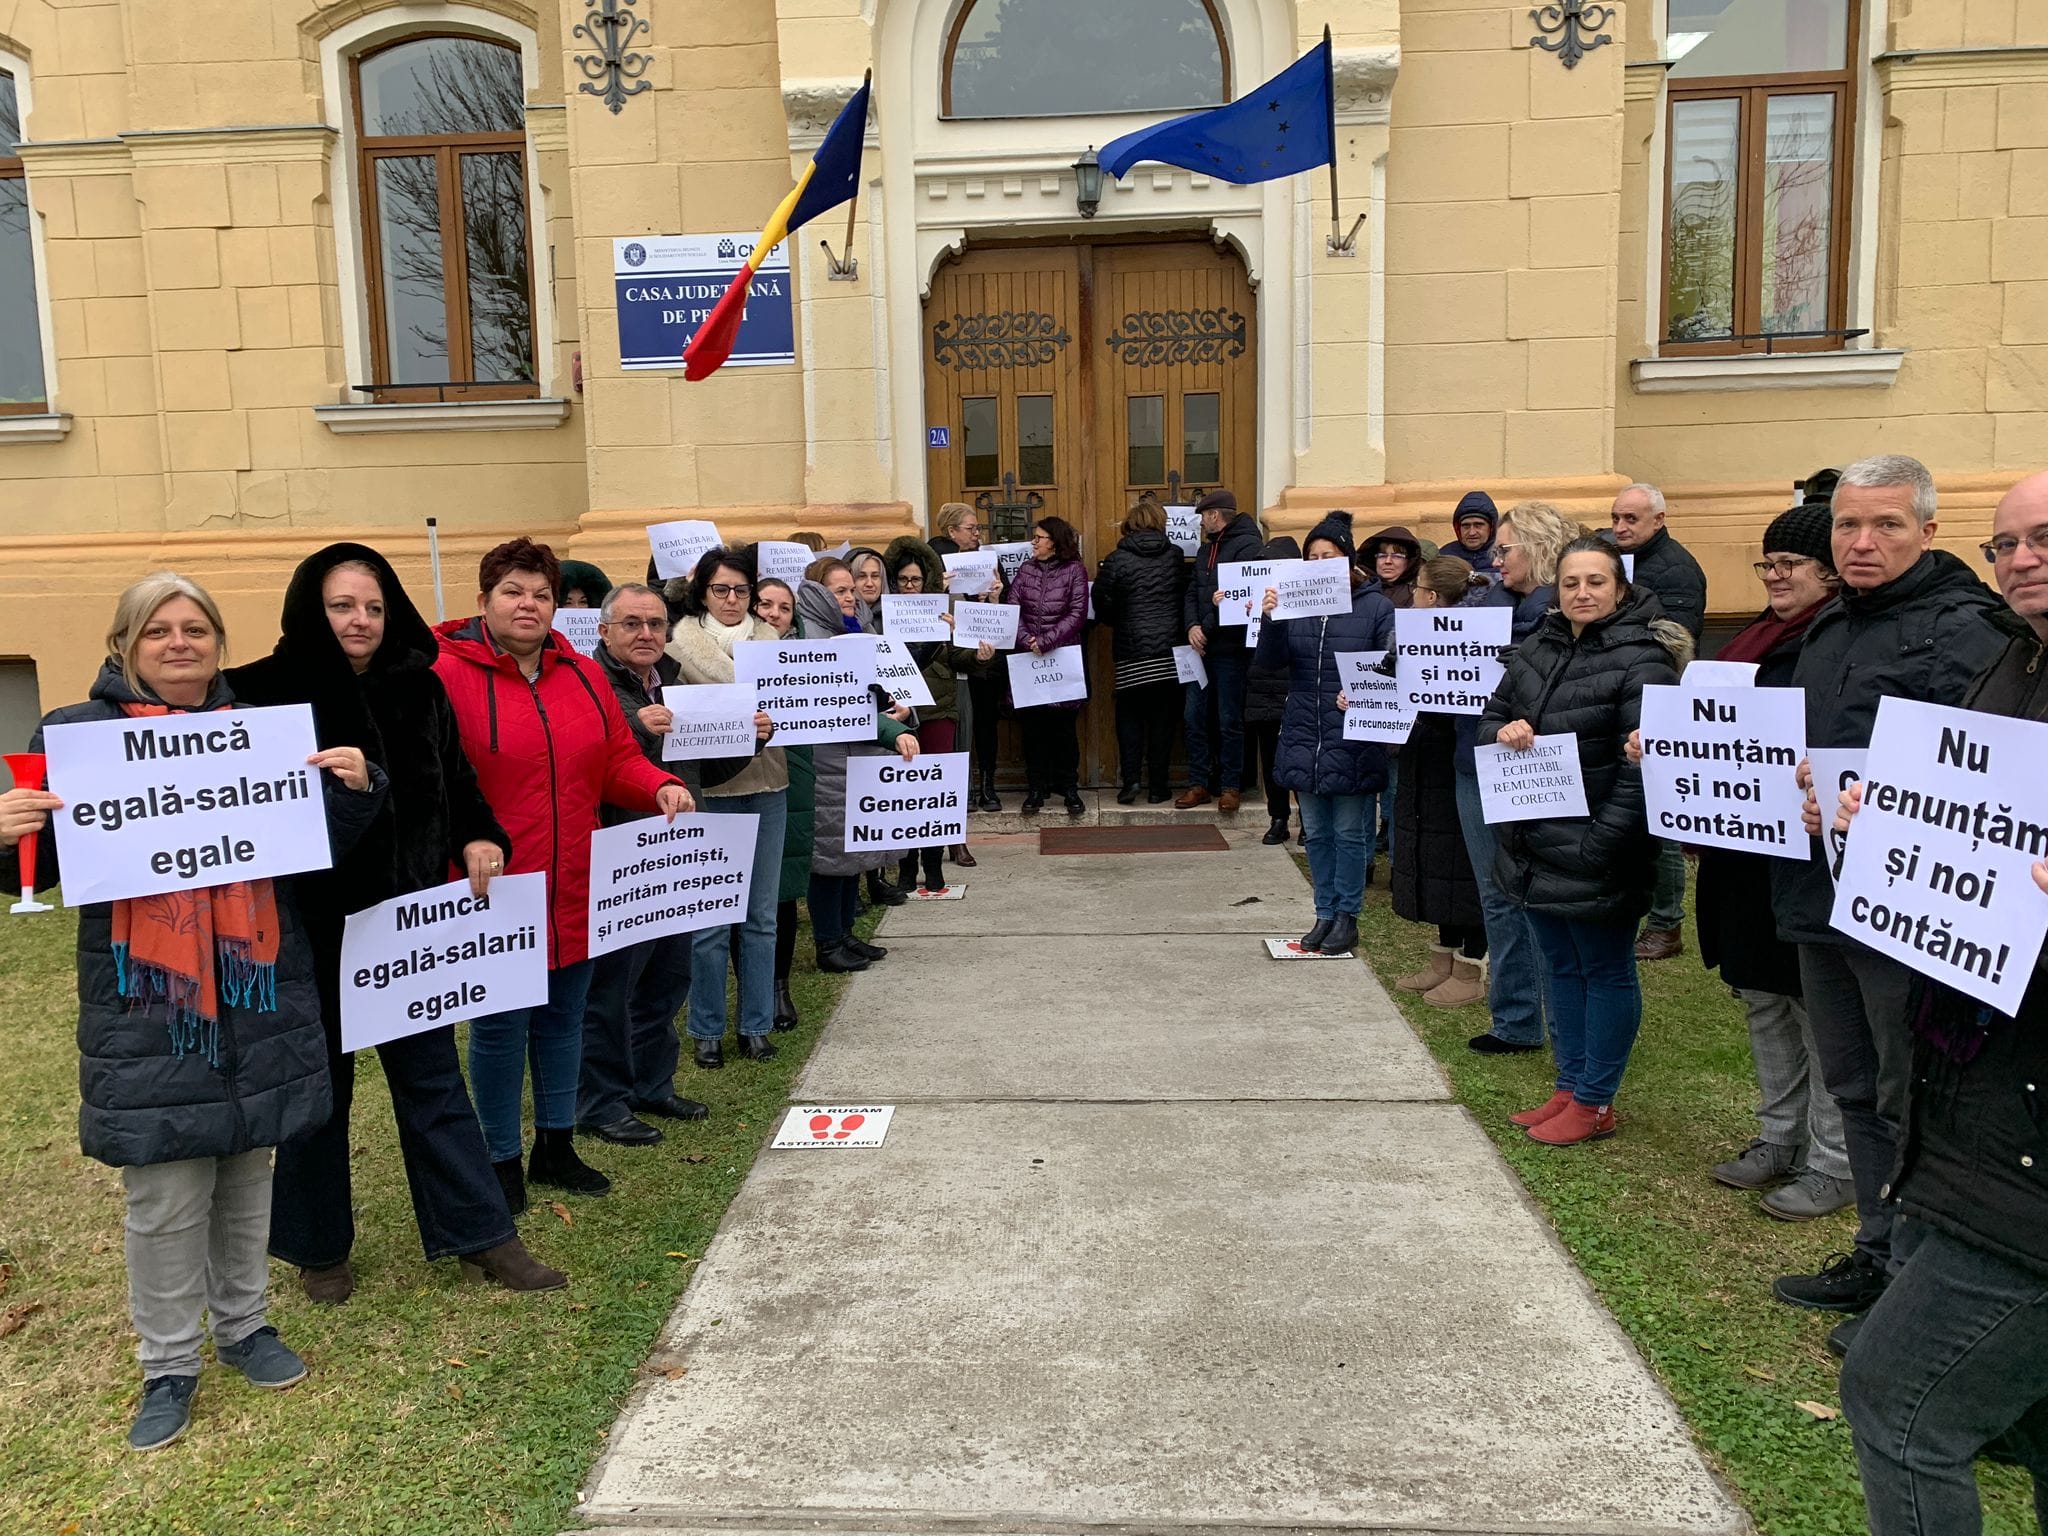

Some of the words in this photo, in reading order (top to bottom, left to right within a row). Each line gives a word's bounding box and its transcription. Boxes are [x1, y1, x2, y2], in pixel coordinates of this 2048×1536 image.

[738, 243, 780, 258] CNP
[625, 286, 673, 302] CASA
[662, 309, 687, 324] DE
[930, 429, 947, 445] 2/A
[658, 535, 716, 550] REMUNERARE
[998, 551, 1032, 563] REVĂ
[1279, 581, 1301, 590] ESTE
[1303, 577, 1340, 587] TIMPUL
[893, 599, 939, 607] TRATAMENT
[1283, 597, 1339, 610] SCHIMBARE
[1286, 589, 1324, 599] PENTRU
[896, 608, 936, 616] ECHITABIL
[973, 617, 1001, 625] MUNCA
[899, 626, 936, 634] CORECTA
[1433, 616, 1463, 632] Nu
[778, 649, 838, 664] Suntem
[1398, 641, 1501, 662] renunțăm
[757, 669, 859, 691] profesioniști,
[1034, 672, 1064, 684] ARAD
[1421, 665, 1439, 686] și
[1447, 666, 1481, 682] noi
[757, 693, 809, 710] erităm
[813, 691, 873, 710] respect
[1349, 698, 1383, 710] merităm
[1692, 698, 1737, 723] Nu
[679, 720, 745, 734] ELIMINAREA
[771, 713, 871, 733] ecunoaștere!
[1348, 717, 1357, 731] și
[123, 720, 252, 763] Muncă
[671, 733, 751, 748] INECHITATILOR
[1494, 745, 1564, 763] TRATAMENT
[1644, 738, 1796, 770] renunțăm
[1937, 727, 1991, 774] Nu
[879, 763, 943, 783] Grevă
[1502, 761, 1563, 777] ECHITABIL
[1493, 775, 1575, 793] REMUNERARE
[1675, 772, 1700, 803] și
[1713, 778, 1761, 802] noi
[72, 770, 310, 831] egală-salarii
[859, 790, 958, 813] Generală
[1511, 791, 1567, 806] CORECTA
[1660, 811, 1787, 845] contăm!
[1863, 780, 2048, 859] renunțăm
[636, 826, 705, 848] Suntem
[852, 825, 884, 843] Nu
[891, 819, 961, 840] cedăm
[151, 834, 256, 879] egale
[612, 847, 729, 885] profesioniști,
[1884, 845, 1921, 888] și
[1929, 861, 1998, 909] noi
[597, 883, 667, 912] merităm
[673, 871, 744, 891] respect
[597, 920, 612, 943] și
[616, 894, 740, 932] recunoaștere!
[1851, 895, 2011, 986] contăm!
[352, 926, 537, 991] egală-salarii
[406, 979, 488, 1022] egale
